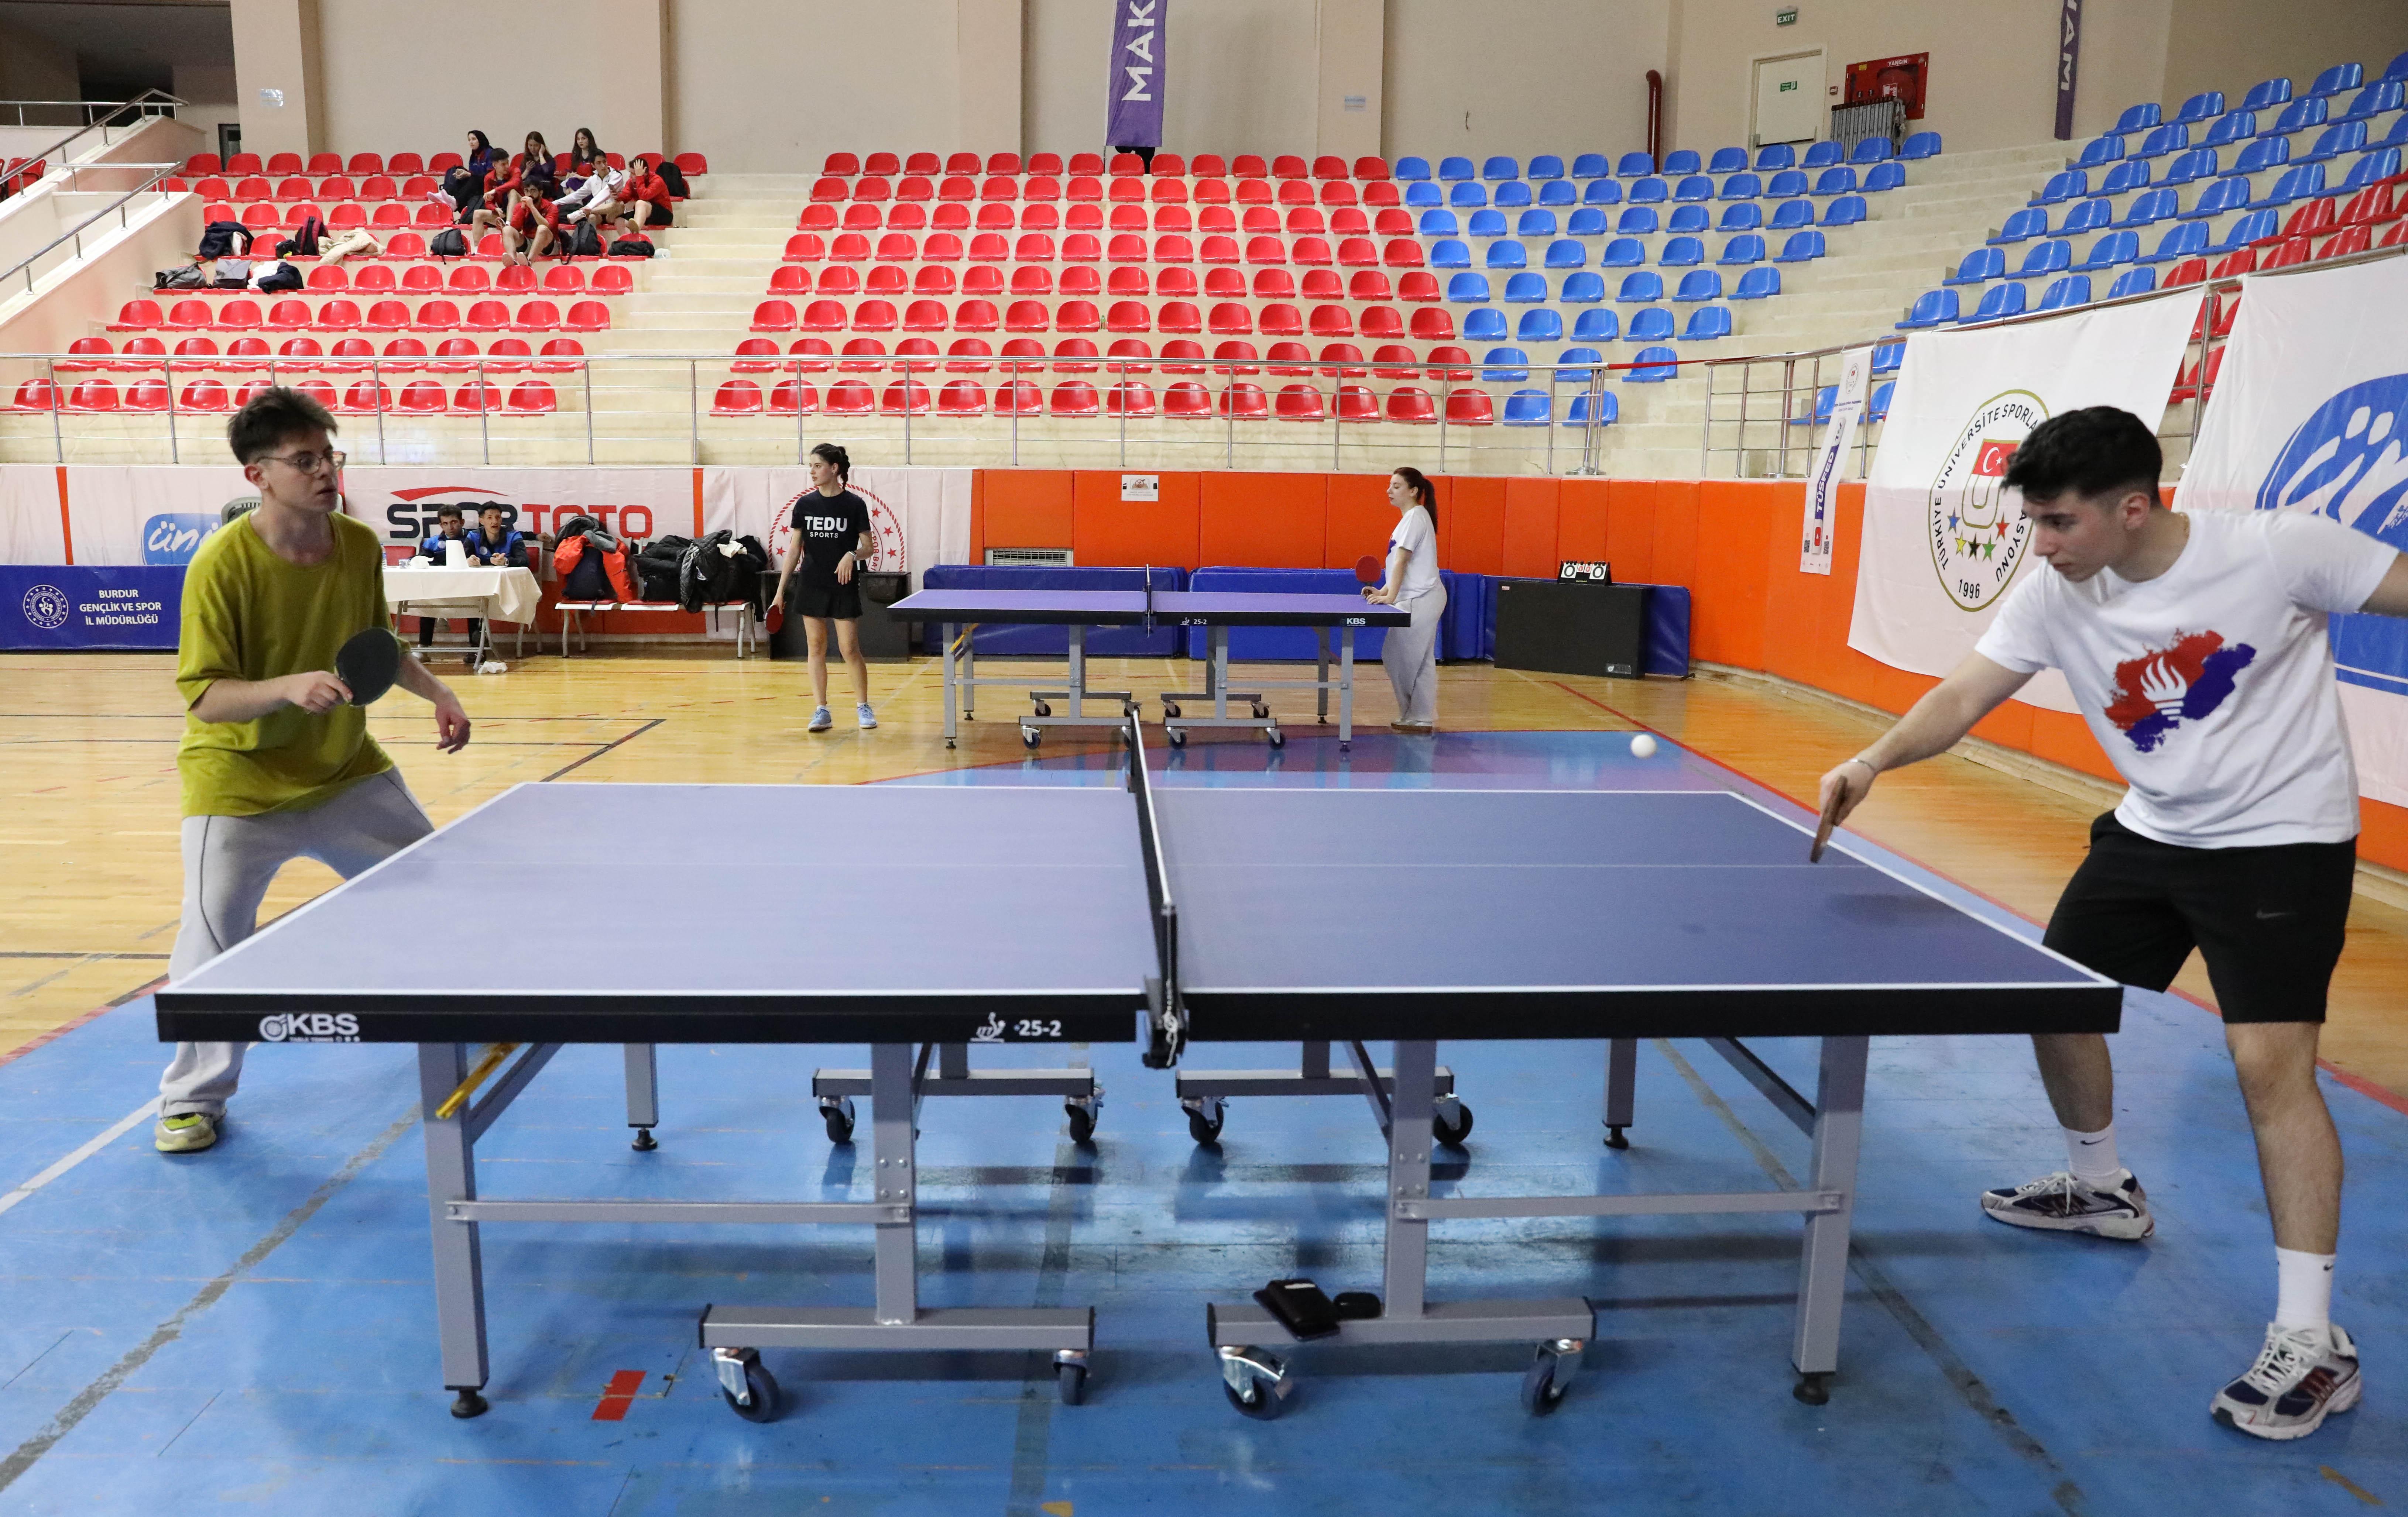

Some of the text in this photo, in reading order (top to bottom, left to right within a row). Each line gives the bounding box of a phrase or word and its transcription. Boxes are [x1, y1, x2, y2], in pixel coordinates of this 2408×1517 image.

[1778, 14, 1795, 23] EXIT
[1816, 451, 1834, 513] TÜSFED
[1933, 404, 2038, 582] TÜRKİYE ÜNİVERSİTE SPORLA ASYONU
[804, 516, 848, 532] TEDU
[1564, 565, 1575, 577] 0
[1592, 566, 1604, 578] 0
[99, 589, 138, 598] BURDUR
[1959, 579, 1980, 599] 1996
[79, 602, 162, 613] GENÇLİK VE SPOR
[85, 613, 158, 625] İL MÜDÜRLÜĞÜ
[288, 1013, 360, 1035] KBS
[1018, 1019, 1062, 1037] 25-2
